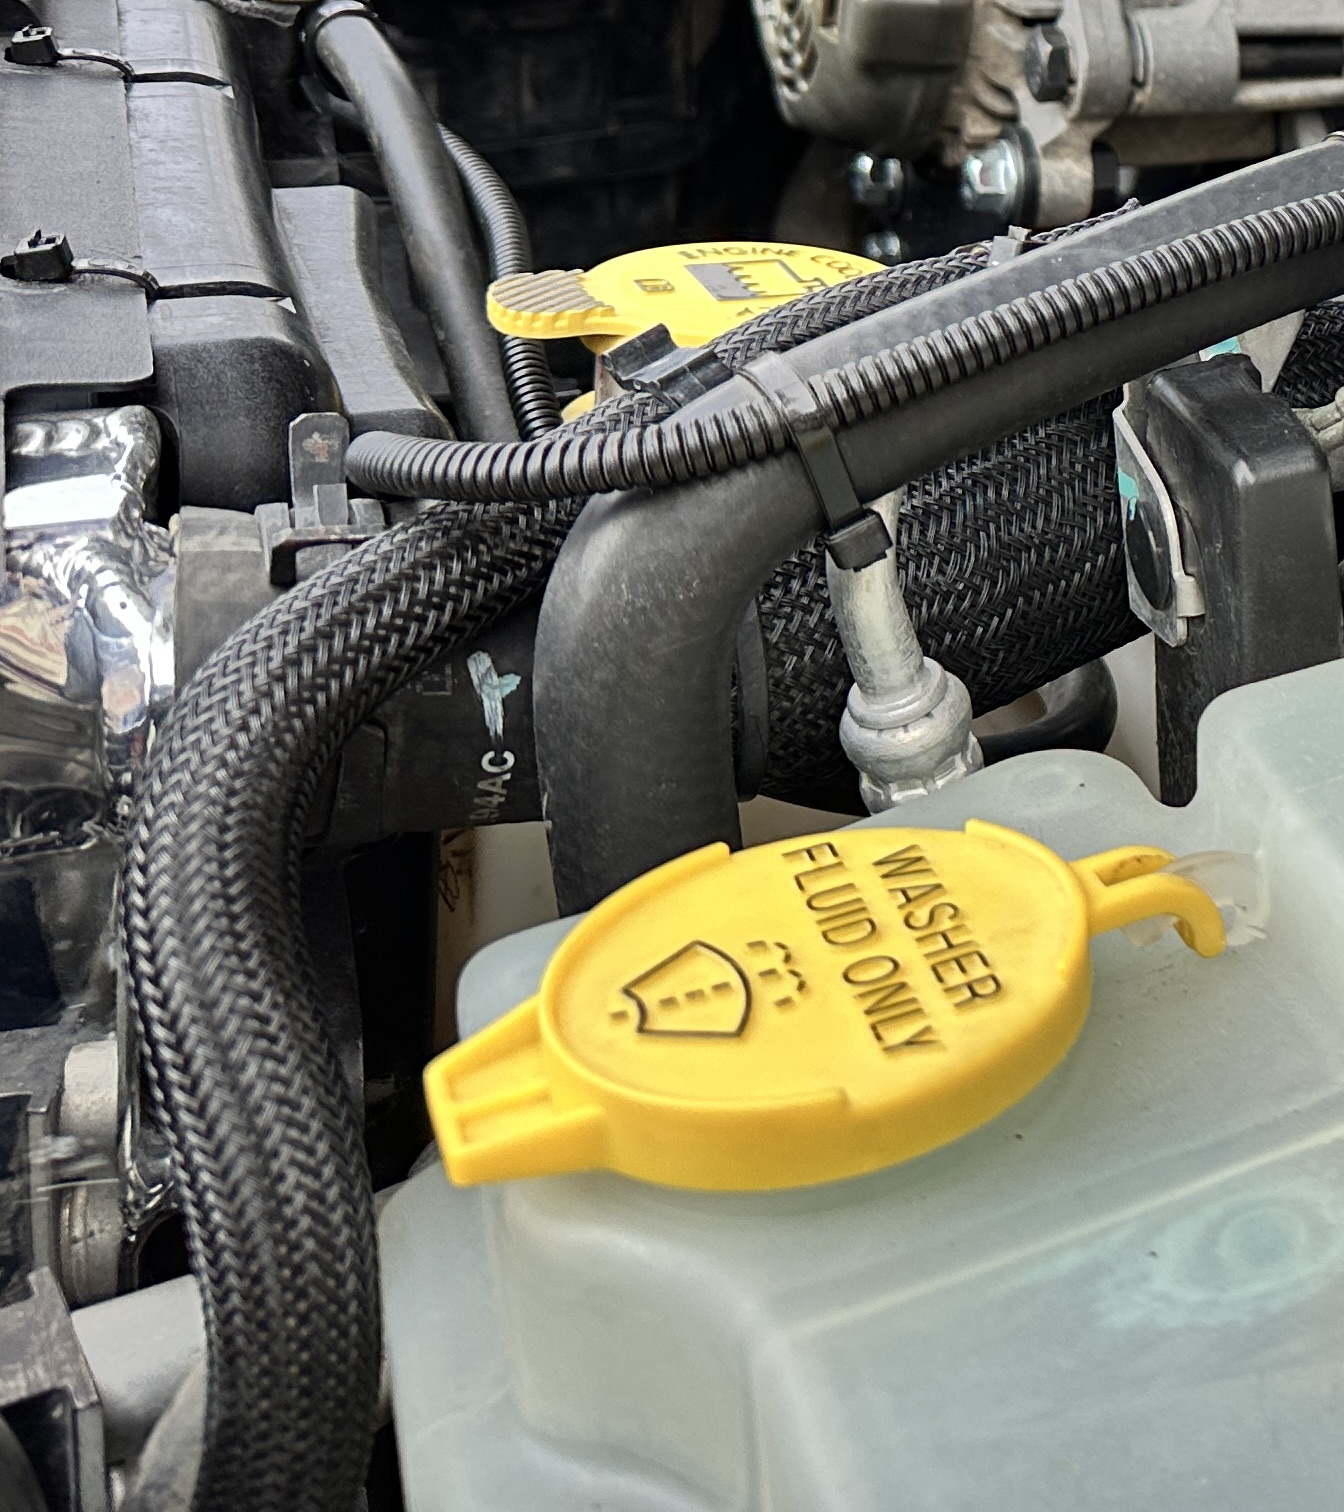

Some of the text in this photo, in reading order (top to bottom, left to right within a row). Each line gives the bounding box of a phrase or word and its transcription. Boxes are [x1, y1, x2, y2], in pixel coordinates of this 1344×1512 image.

[783, 841, 948, 1057] FLUID ONLY
[871, 843, 1004, 1012] WASHER
